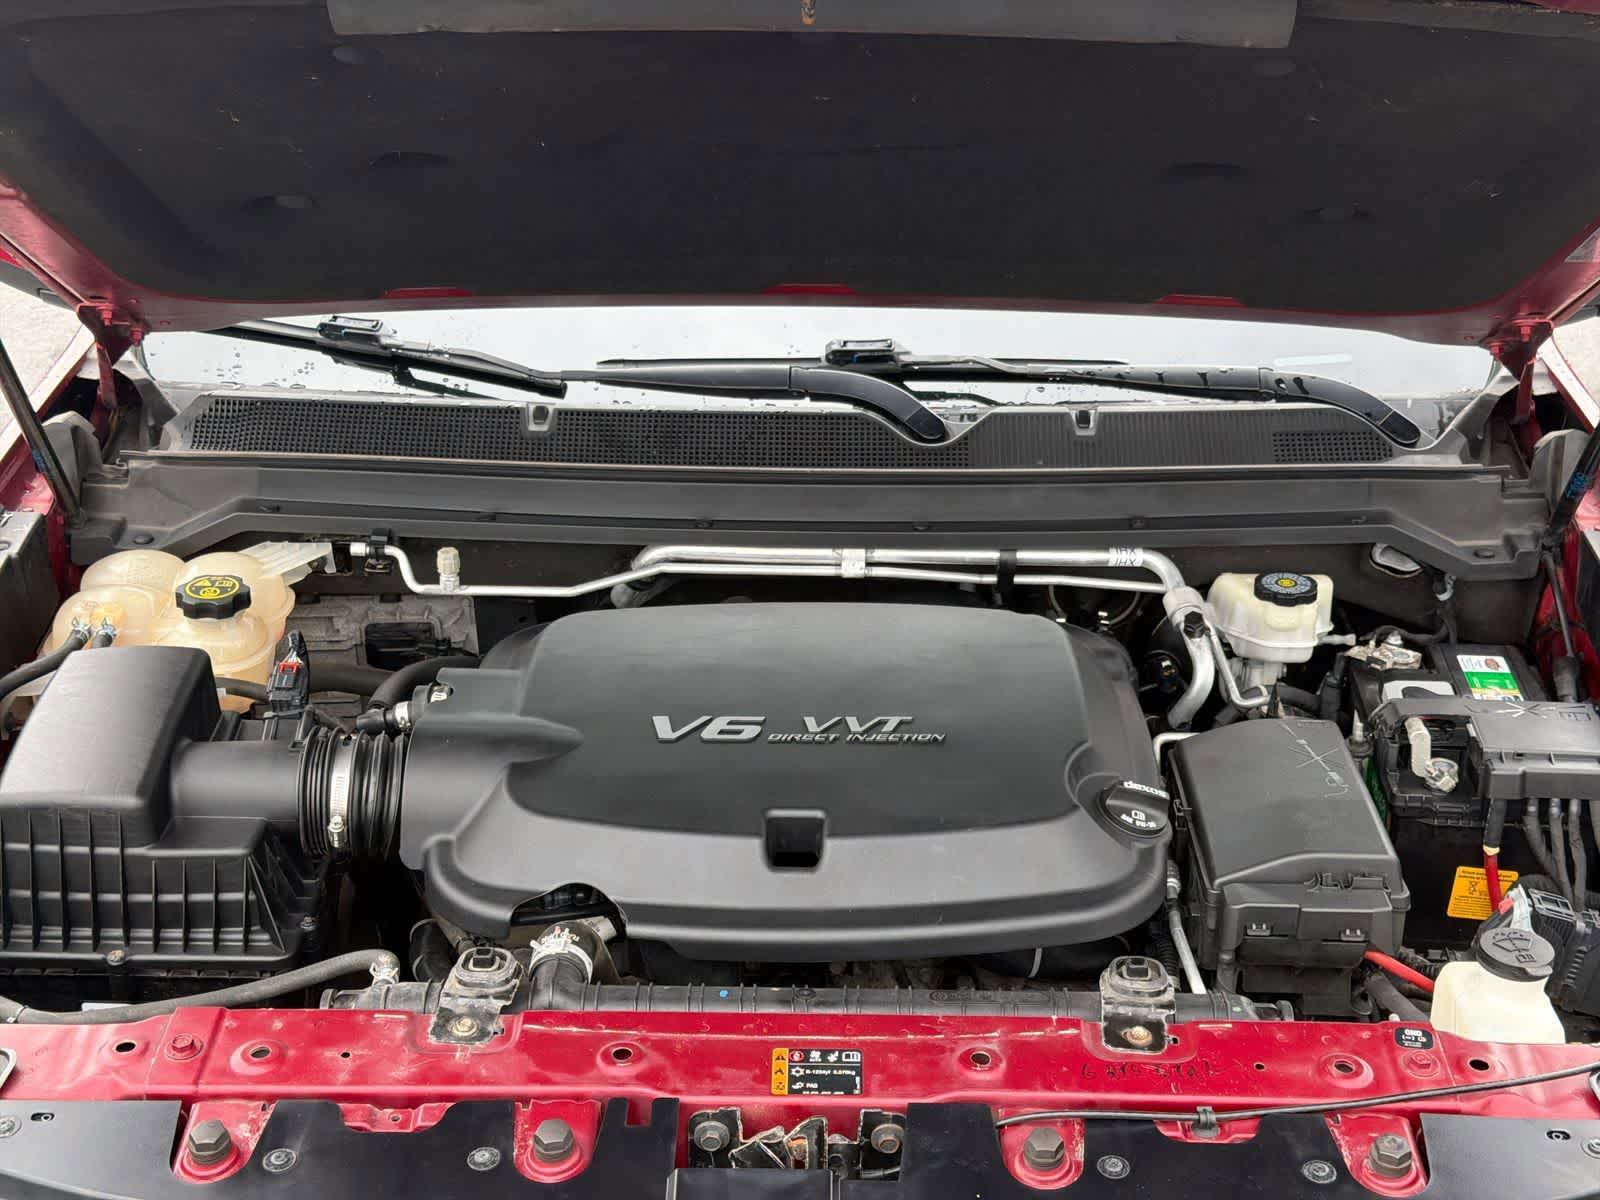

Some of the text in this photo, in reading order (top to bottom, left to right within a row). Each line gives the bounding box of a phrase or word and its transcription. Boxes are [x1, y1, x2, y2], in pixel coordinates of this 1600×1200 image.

[652, 715, 766, 742] V6
[803, 716, 913, 733] VVT
[768, 733, 945, 743] DIRECT INJECTION
